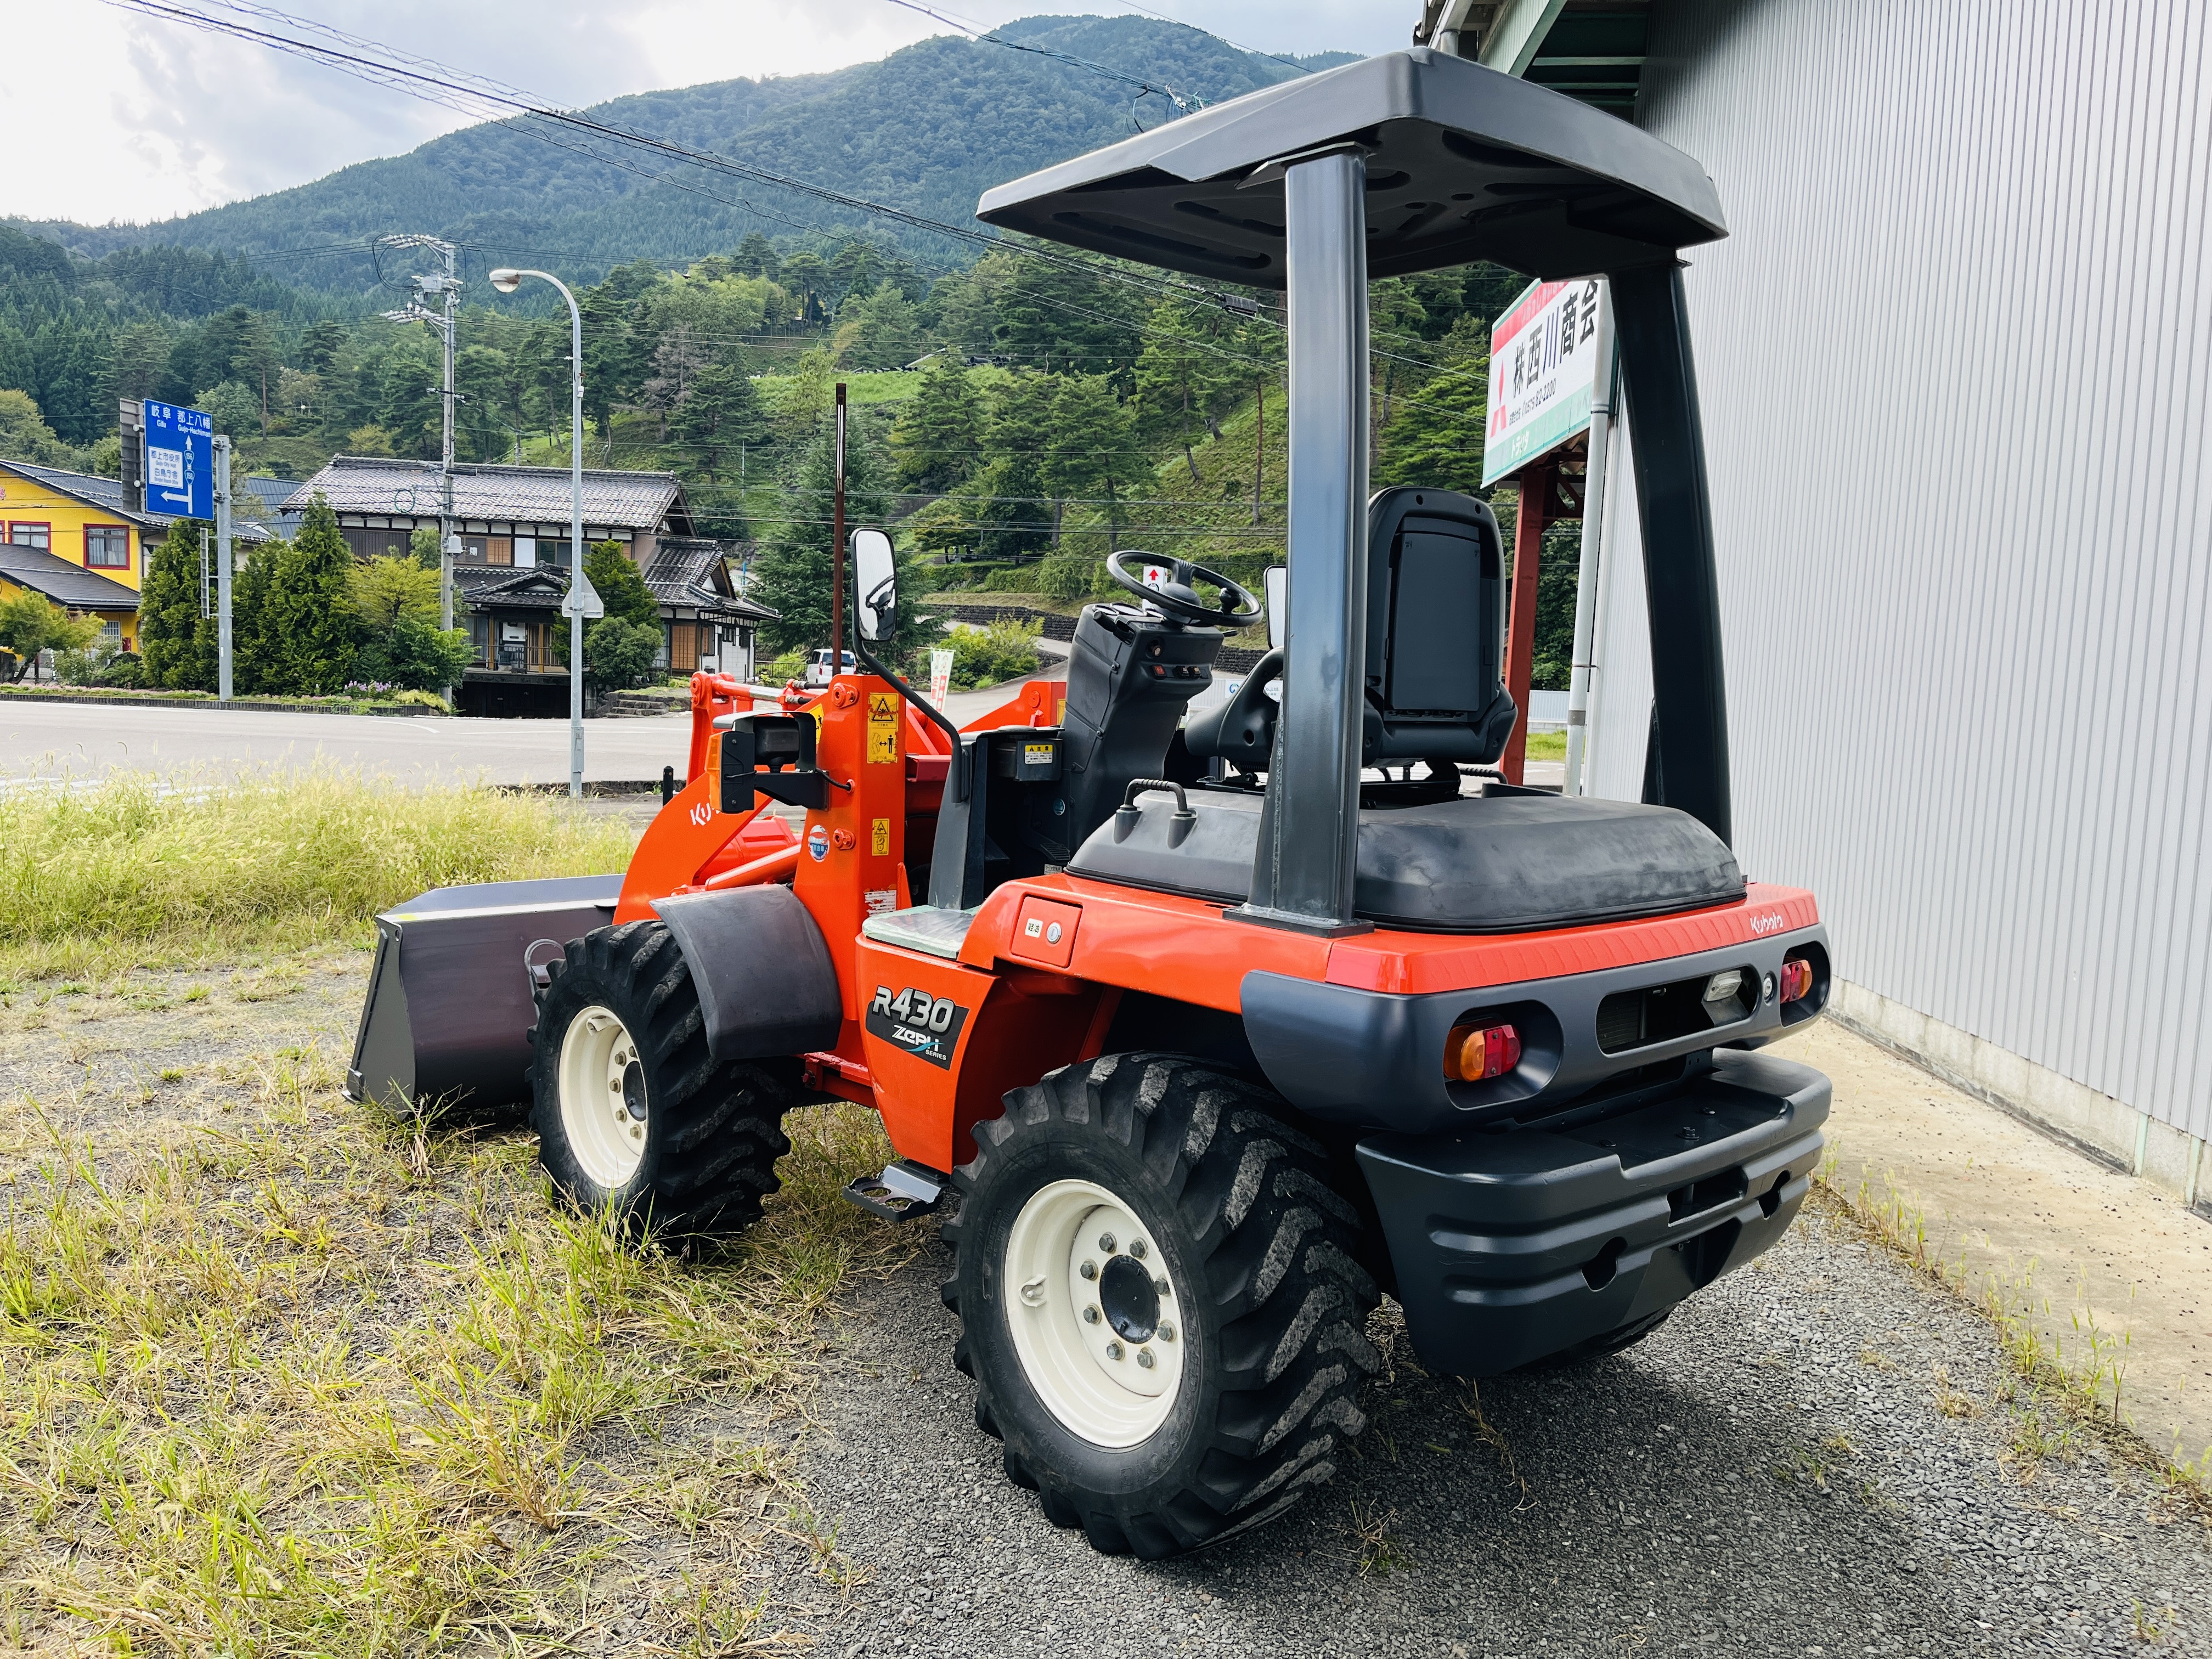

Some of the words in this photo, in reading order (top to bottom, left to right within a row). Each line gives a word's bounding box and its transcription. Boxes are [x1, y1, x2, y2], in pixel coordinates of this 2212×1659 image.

[151, 404, 171, 420] 岐阜
[177, 410, 211, 429] 郡上八幡
[156, 419, 166, 428] Gifu
[178, 424, 211, 437] Gujo-Hachiman
[151, 450, 180, 463] 郡上市役所
[155, 467, 178, 479] 白鳥庁舎
[1750, 912, 1783, 934] Kubota
[873, 986, 954, 1032] R430
[925, 1049, 946, 1060] SERIES
